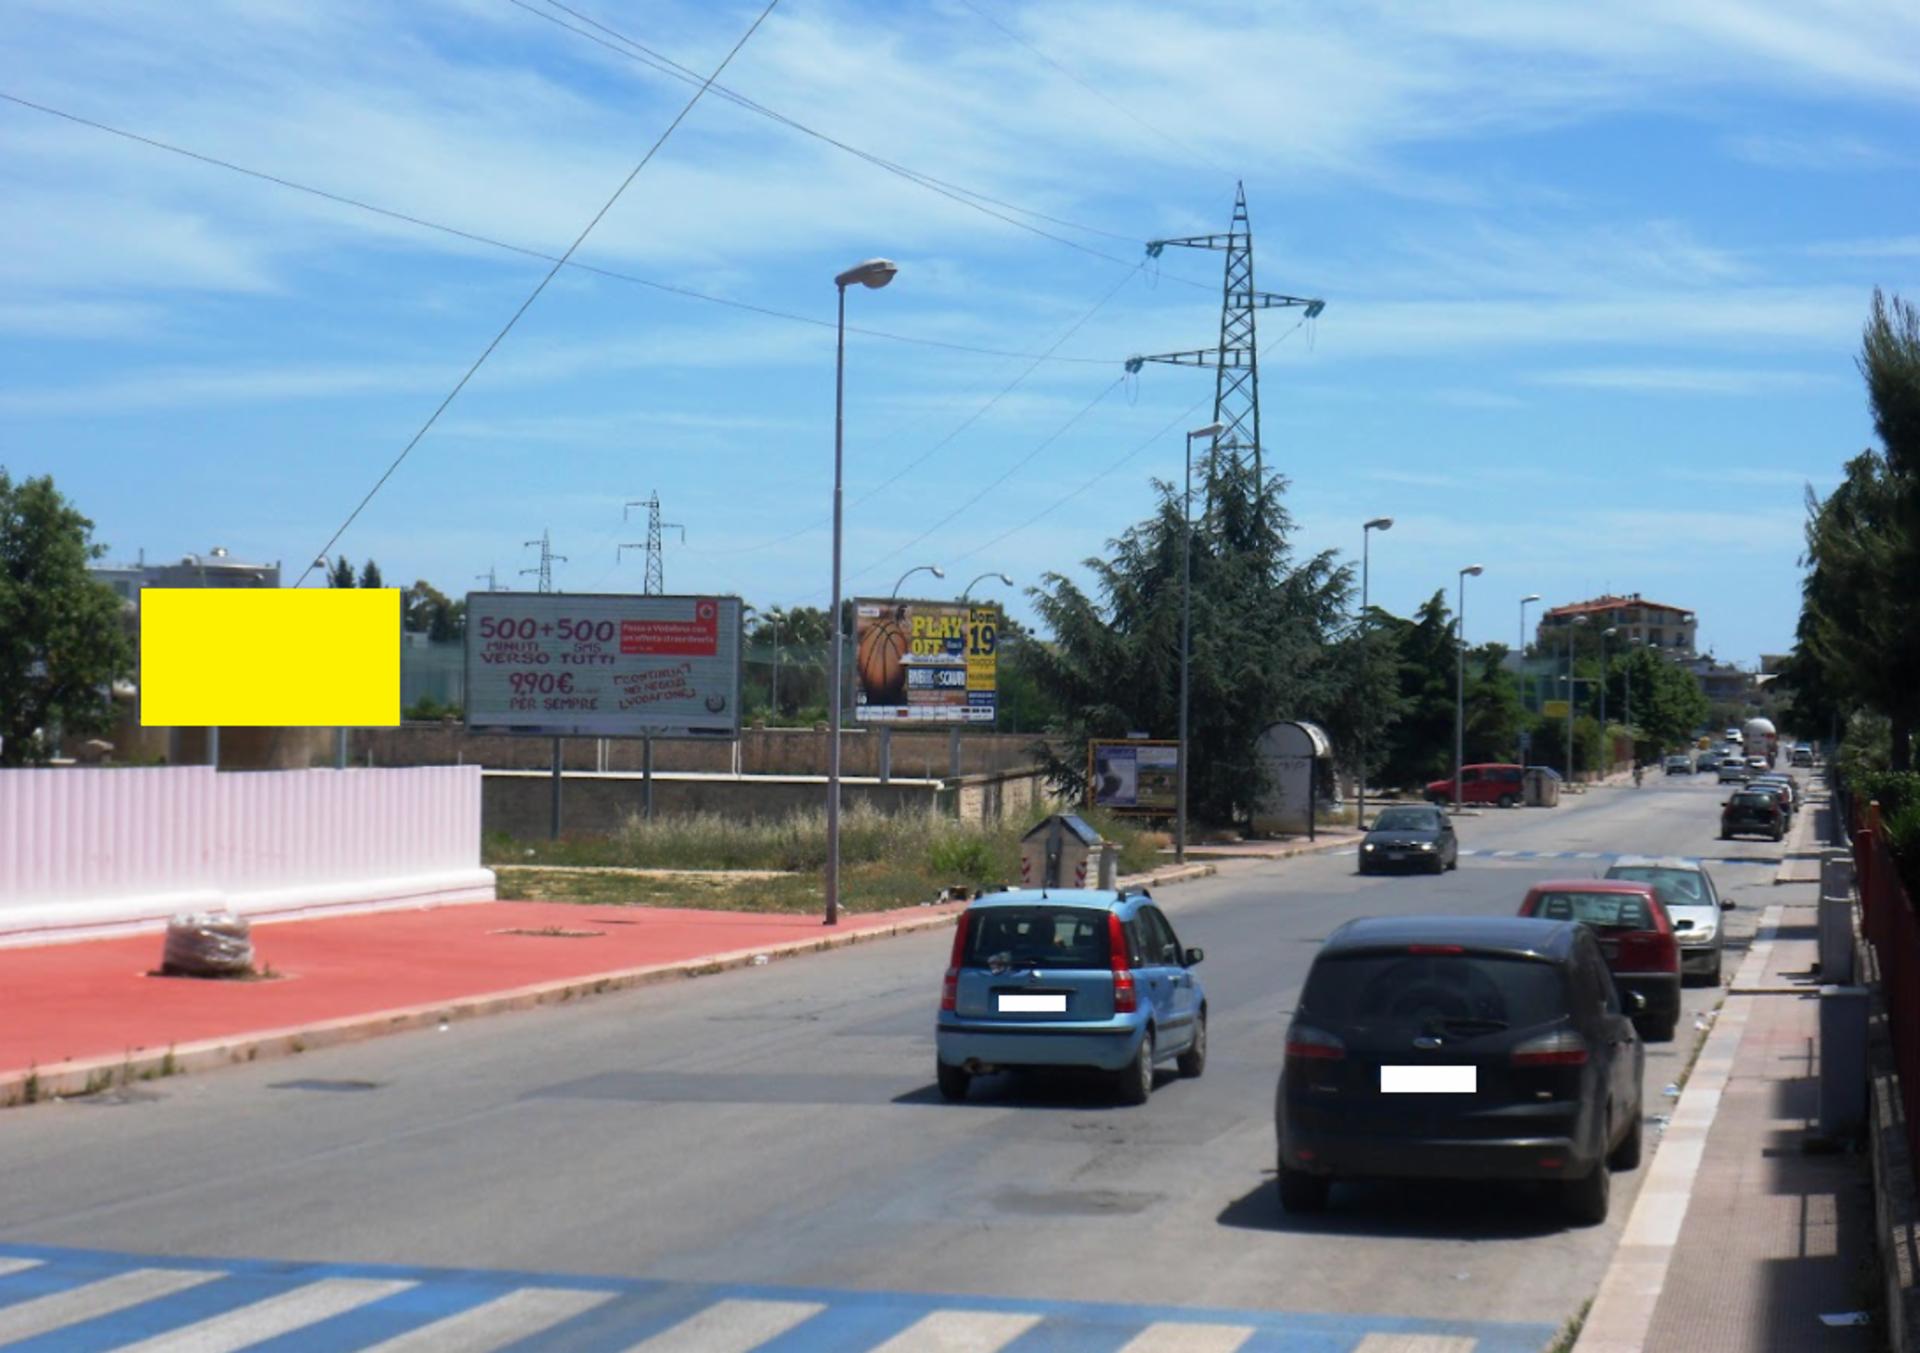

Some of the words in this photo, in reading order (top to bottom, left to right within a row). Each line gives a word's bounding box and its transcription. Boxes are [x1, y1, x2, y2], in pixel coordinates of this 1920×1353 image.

[480, 615, 615, 641] 500+500
[911, 615, 962, 639] PLAY
[486, 641, 539, 651] MINUTI
[573, 642, 602, 653] SMS
[911, 638, 944, 657] OFF
[970, 625, 996, 656] 19
[480, 652, 550, 665] VERSO
[560, 653, 616, 665] TUTTI
[509, 697, 537, 710] PER
[543, 697, 599, 711] SEMPRE
